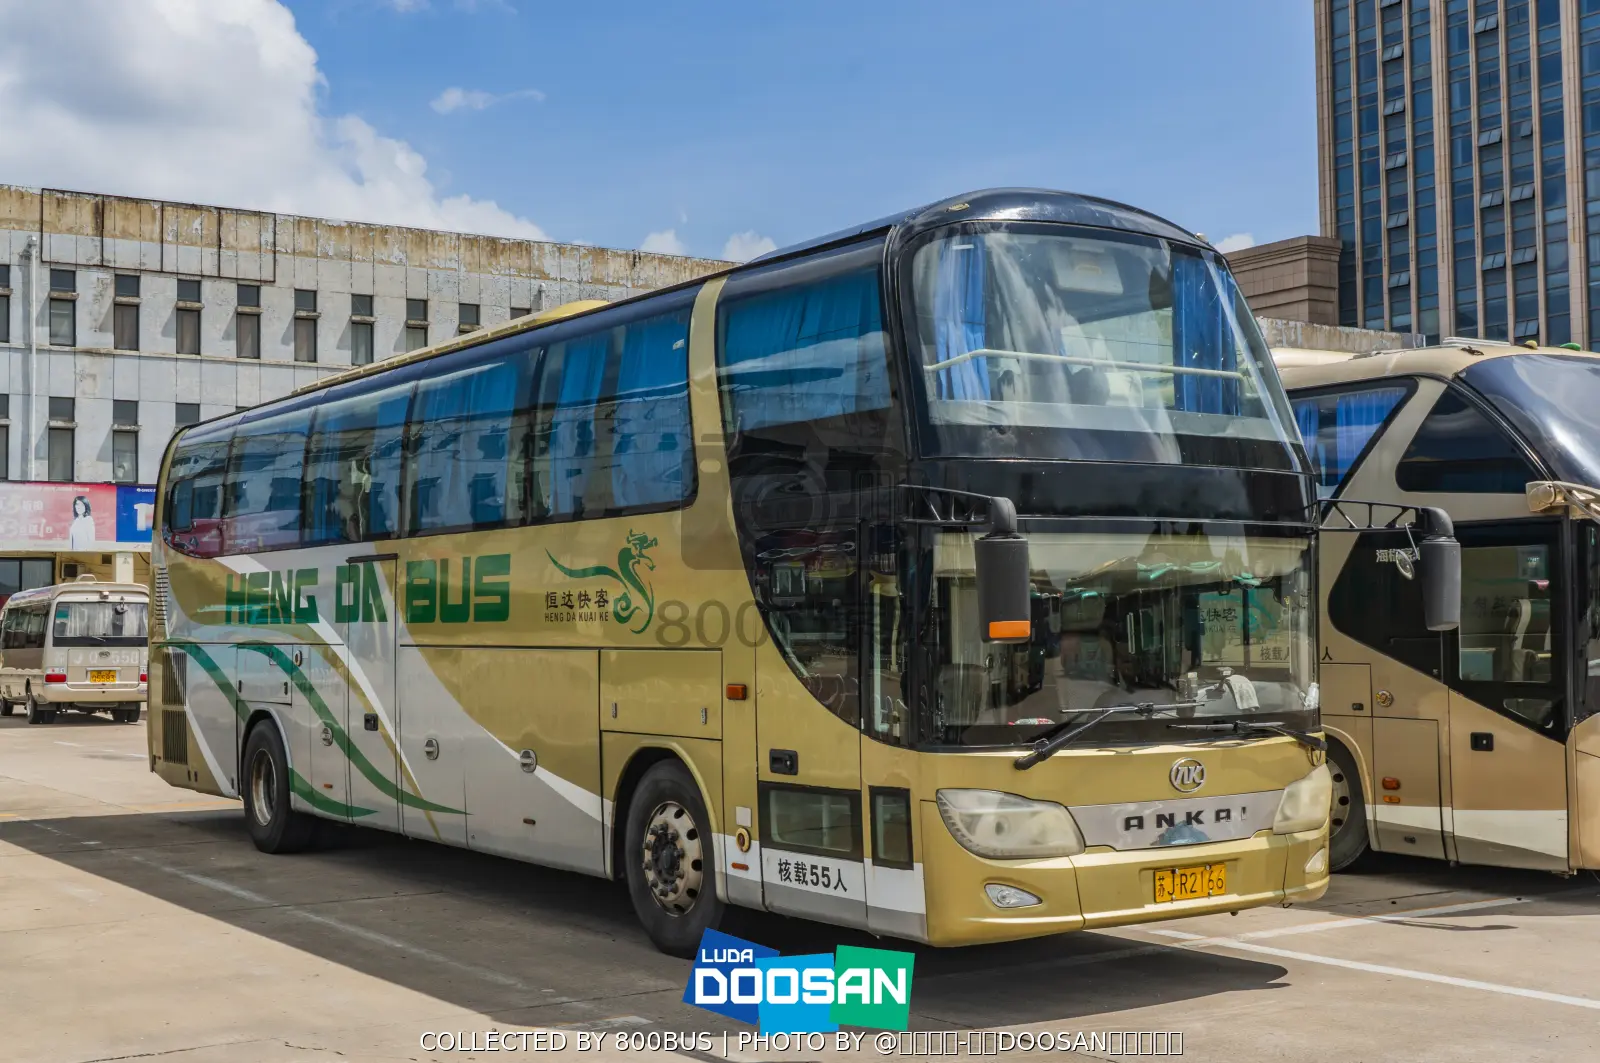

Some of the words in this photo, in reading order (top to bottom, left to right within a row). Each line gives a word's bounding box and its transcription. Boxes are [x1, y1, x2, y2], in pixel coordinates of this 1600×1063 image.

[225, 567, 320, 625] HENG
[335, 559, 389, 624] DA
[406, 554, 512, 624] BUS
[544, 588, 609, 610] 恒达快客
[544, 612, 564, 623] HENG
[566, 611, 577, 622] DA
[578, 611, 597, 622] KUAI
[599, 611, 609, 622] KE
[778, 858, 848, 892] 核载55人
